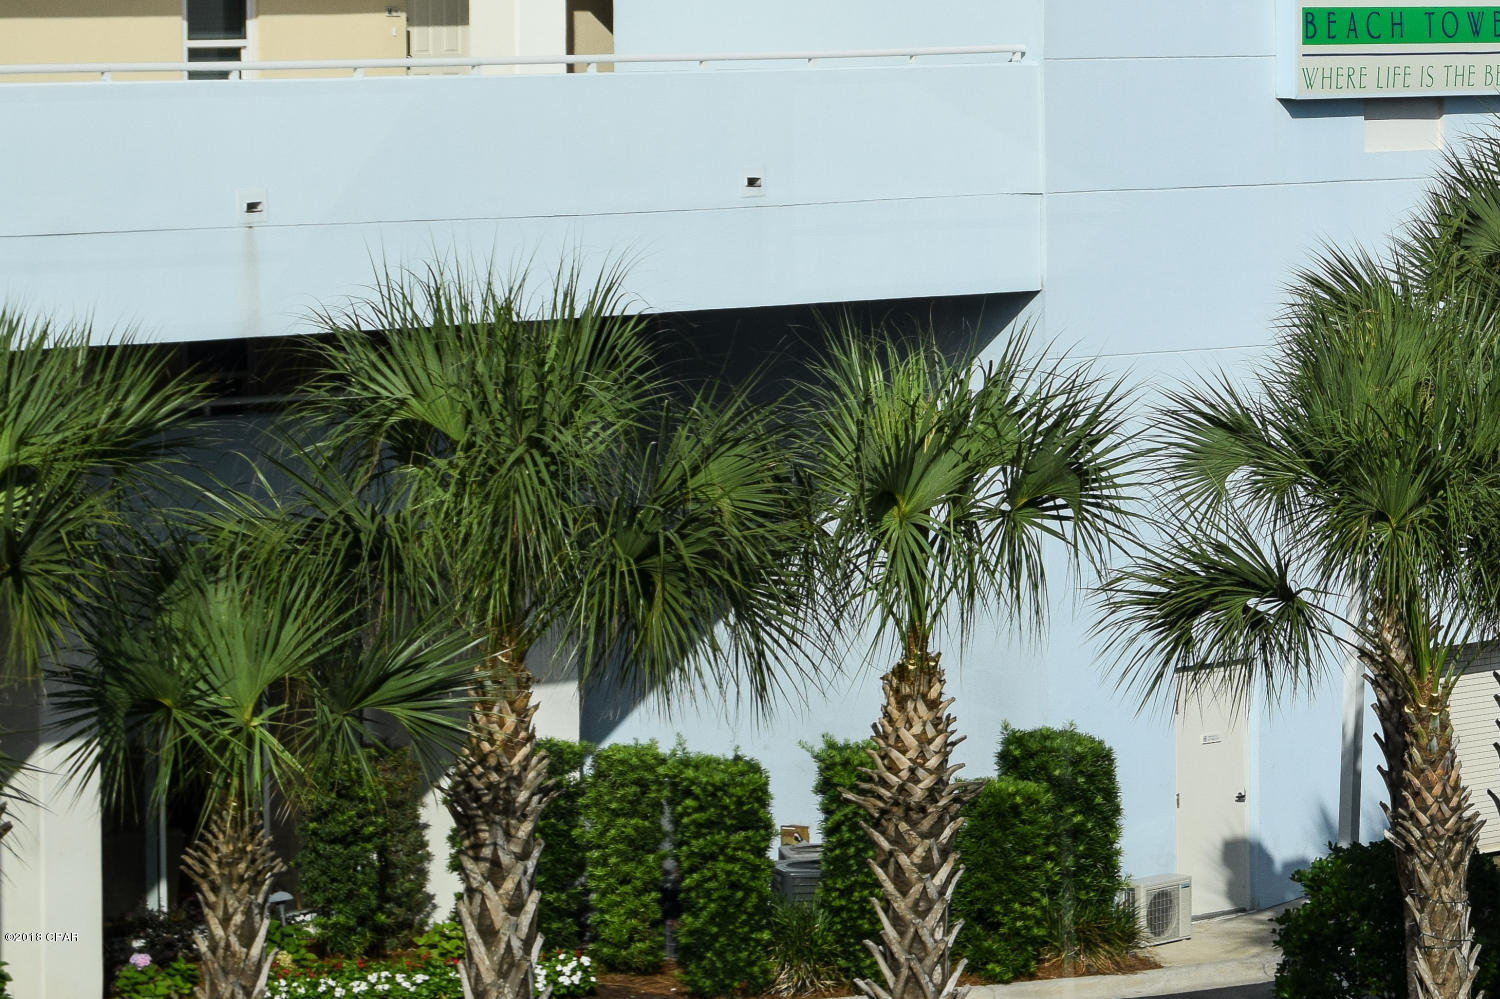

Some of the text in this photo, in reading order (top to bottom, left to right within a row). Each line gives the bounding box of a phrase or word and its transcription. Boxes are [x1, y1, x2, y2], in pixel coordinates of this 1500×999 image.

[1304, 11, 1404, 40] BEACH
[1301, 66, 1367, 90] WHERE
[1376, 65, 1412, 89] LIFE
[1420, 65, 1434, 88] IS
[1443, 64, 1476, 87] THE
